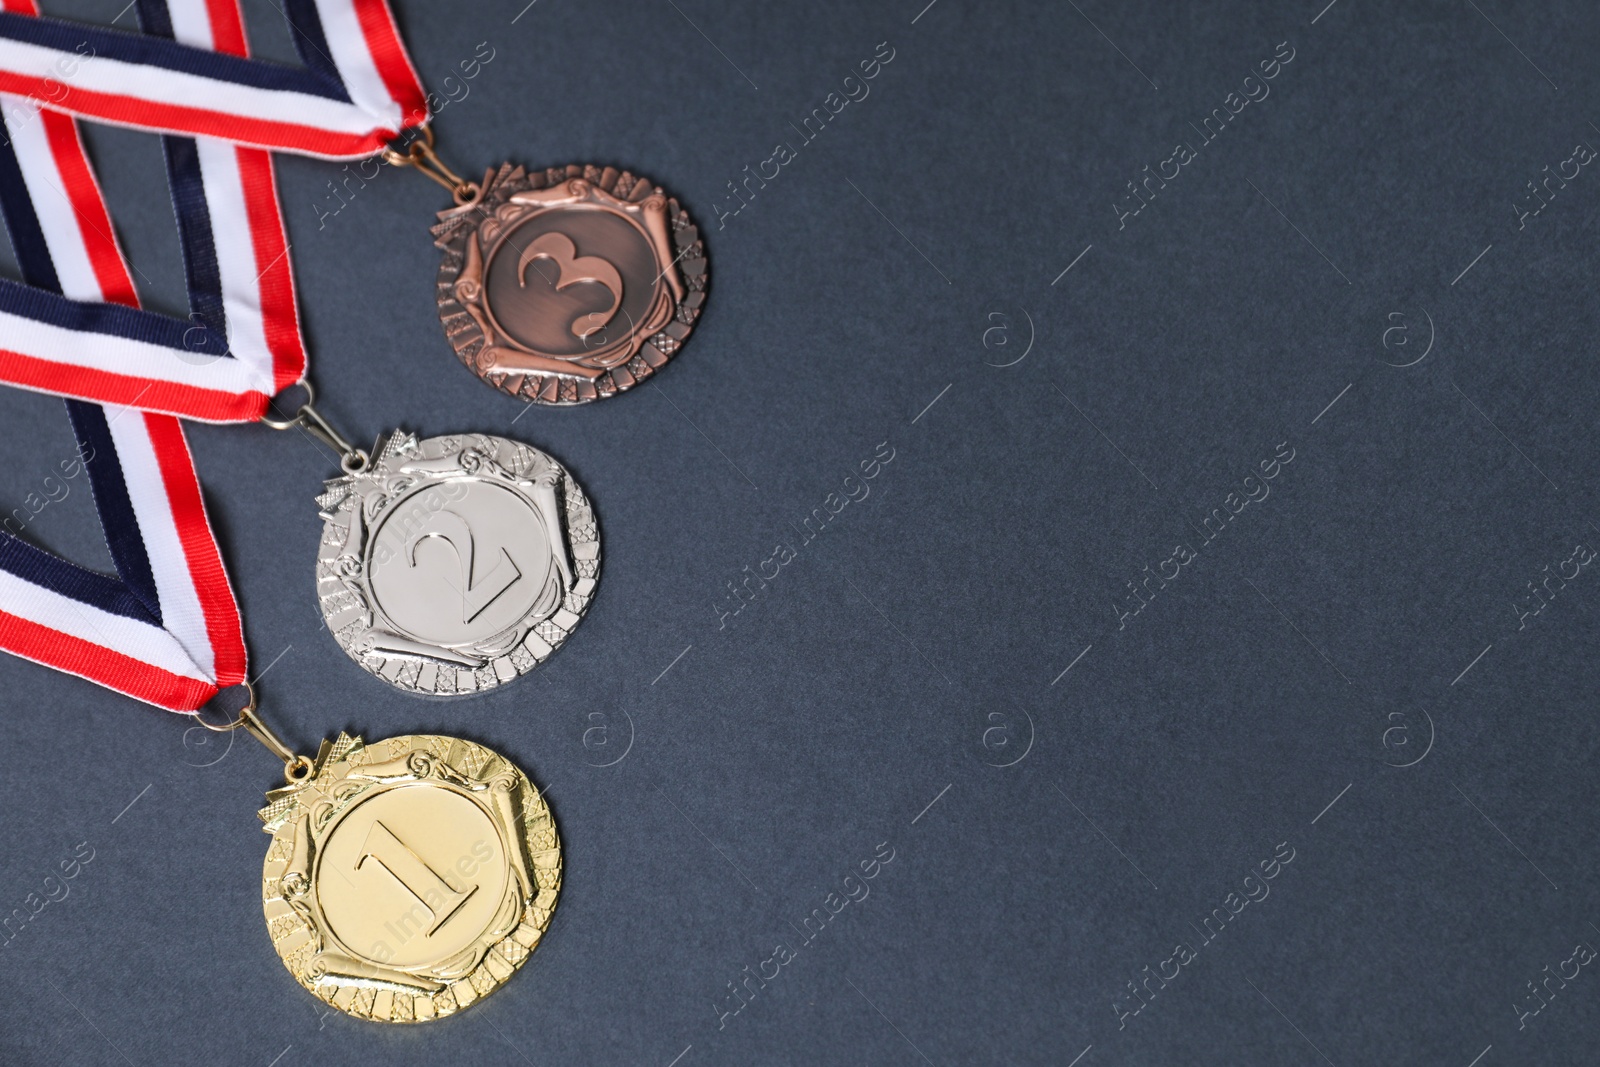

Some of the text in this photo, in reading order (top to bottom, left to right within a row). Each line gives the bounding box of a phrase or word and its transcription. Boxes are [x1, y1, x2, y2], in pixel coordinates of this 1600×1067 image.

[518, 231, 623, 338] 3
[404, 509, 522, 624] 2
[354, 819, 480, 938] 1
